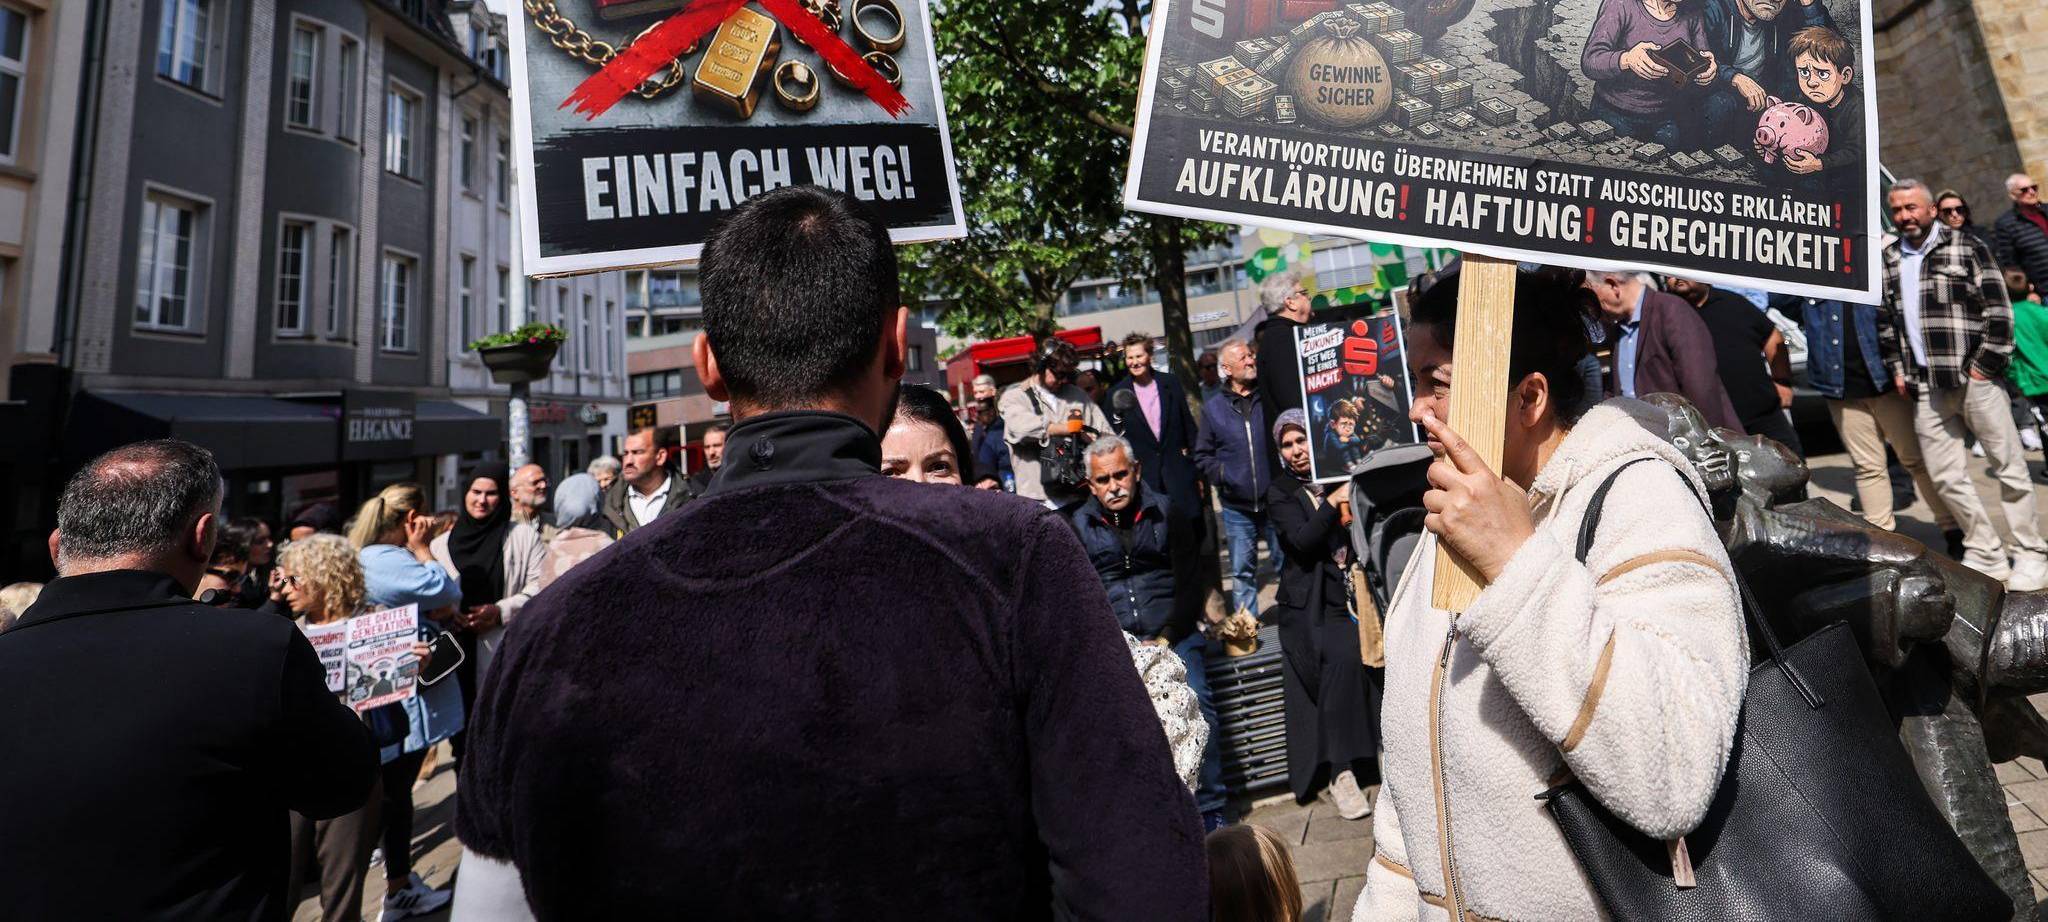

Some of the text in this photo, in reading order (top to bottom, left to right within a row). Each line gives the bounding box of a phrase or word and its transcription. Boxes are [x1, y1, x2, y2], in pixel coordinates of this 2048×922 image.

[1309, 63, 1382, 84] GEWINNE
[1317, 86, 1375, 106] SICHER
[582, 145, 915, 221] EINFACH WEG!
[1199, 129, 1842, 229] VERANTWORTUNG ÜBERNEHMEN STATT AUSSCHLUSS ERKLÄREN!
[1175, 158, 1852, 274] AUFKLÄRUNG! HAFTUNG! GERECHTIGKEIT!
[1303, 323, 1327, 338] MEINE
[1308, 348, 1336, 365] IST WEG
[1316, 359, 1338, 373] EINER
[1307, 370, 1340, 391] NACHT.
[348, 418, 412, 442] ELEGANCE
[356, 607, 408, 628] DIE DRITTE
